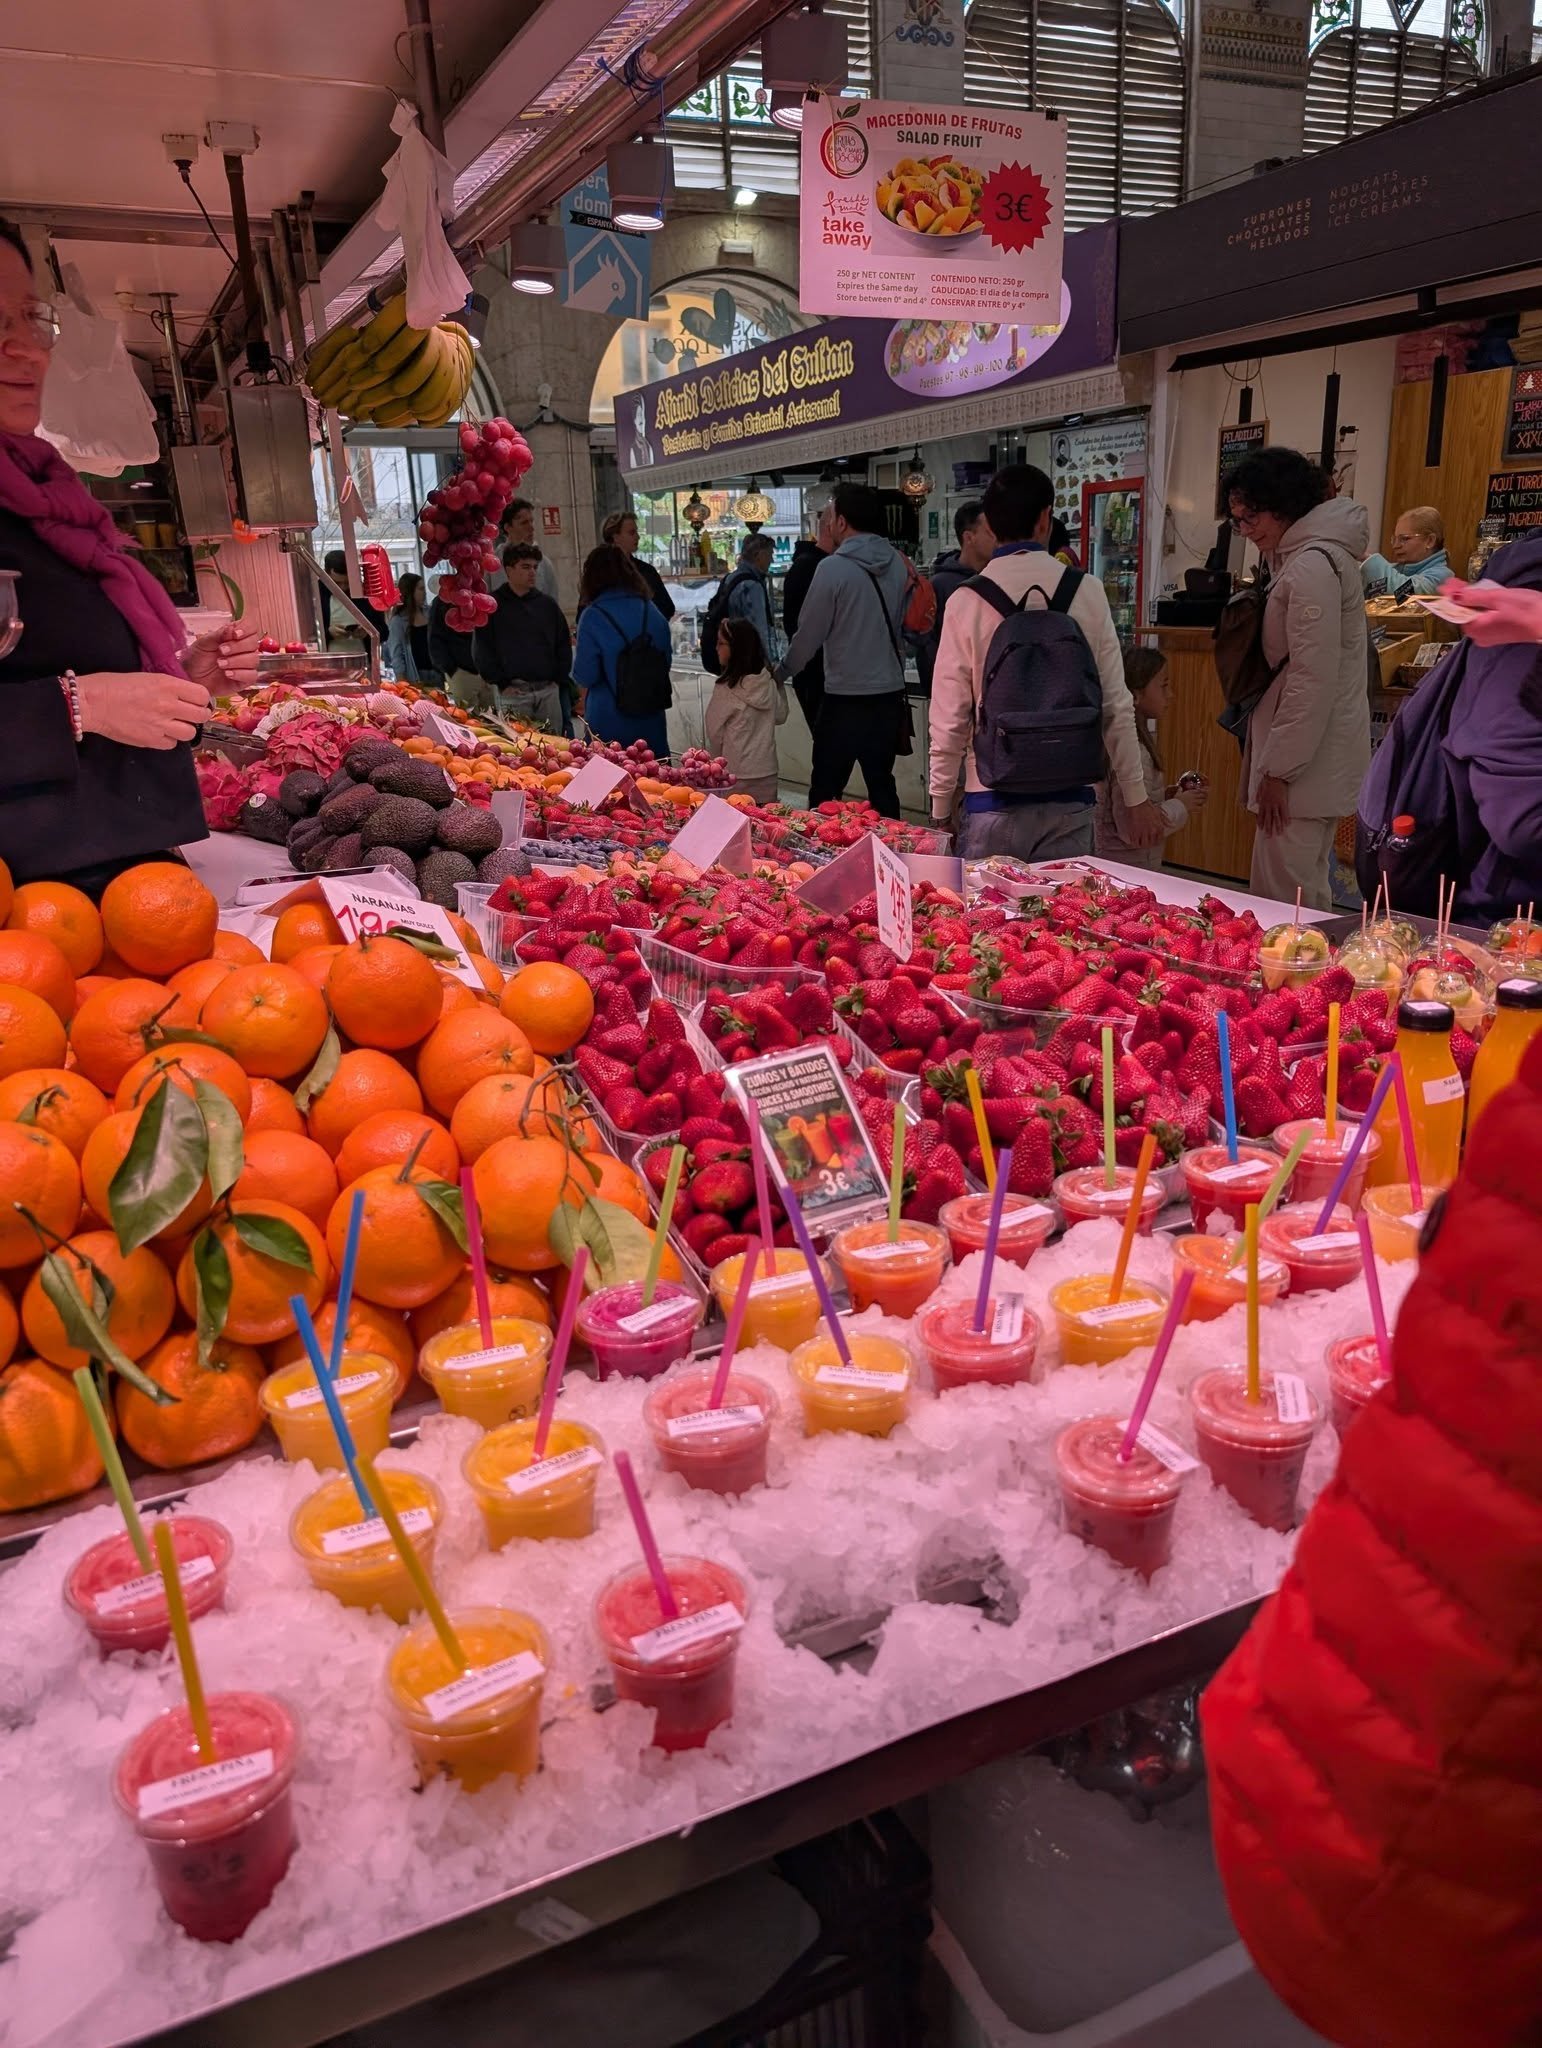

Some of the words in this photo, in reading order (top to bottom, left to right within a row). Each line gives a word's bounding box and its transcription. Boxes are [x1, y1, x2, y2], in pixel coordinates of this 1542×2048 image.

[866, 112, 946, 129] MACEDONIA
[953, 114, 968, 128] DE
[971, 117, 1023, 139] FRUTAS
[896, 130, 939, 145] SALAD
[943, 133, 983, 148] FRUIT
[1329, 169, 1400, 200] NOUGATS
[1328, 175, 1428, 215] CHOCOLATES
[995, 192, 1034, 222] 3€
[1242, 198, 1311, 228] TURRONES
[1328, 214, 1351, 228] ICE
[1360, 192, 1422, 218] CREAMS
[822, 216, 865, 233] take
[1227, 212, 1311, 245] CHOCOLATES
[822, 232, 872, 250] away
[1250, 226, 1310, 251] HELADOS
[836, 270, 850, 278] 250
[851, 272, 860, 281] gr
[862, 271, 877, 279] NET
[878, 272, 916, 281] CONTENT
[930, 274, 977, 284] CONTENIDO
[978, 276, 1001, 285] NETO:
[1002, 278, 1016, 286] 250
[1017, 279, 1025, 288] gr
[836, 281, 865, 292] Expires
[866, 282, 880, 291] the
[881, 283, 902, 292] Same
[903, 284, 919, 295] day
[931, 286, 979, 296] CADUCIDAD:
[980, 288, 987, 296] El
[1001, 289, 1011, 298] de
[1012, 290, 1020, 298] la
[1021, 291, 1050, 300] compra
[836, 293, 857, 301] Store
[858, 294, 892, 303] between
[903, 296, 918, 304] and
[930, 298, 976, 307] CONSERVAR
[977, 300, 1001, 308] ENTRE
[700, 367, 760, 414] Delicias
[761, 349, 789, 398] del
[790, 336, 854, 389] Sultan
[702, 426, 710, 451] y
[710, 416, 743, 444] Comida
[744, 404, 784, 436] Oriental
[785, 389, 840, 429] Artesanal
[1223, 427, 1263, 444] PELADILLAS
[1490, 495, 1505, 508] DE
[1163, 583, 1178, 591] VISA
[352, 893, 416, 915] NARANJAS
[400, 918, 415, 926] MUY
[415, 921, 435, 930] DULCE
[743, 1070, 780, 1089] ZUMOS
[778, 1068, 788, 1080] Y
[787, 1058, 828, 1078] BATIDOS
[756, 1093, 783, 1109] JUICES
[782, 1091, 791, 1102] &
[789, 1080, 836, 1100] SMOOTHIES
[818, 1169, 850, 1196] 3€
[655, 1619, 693, 1638] FRESA
[171, 1768, 218, 1788] FRESA
